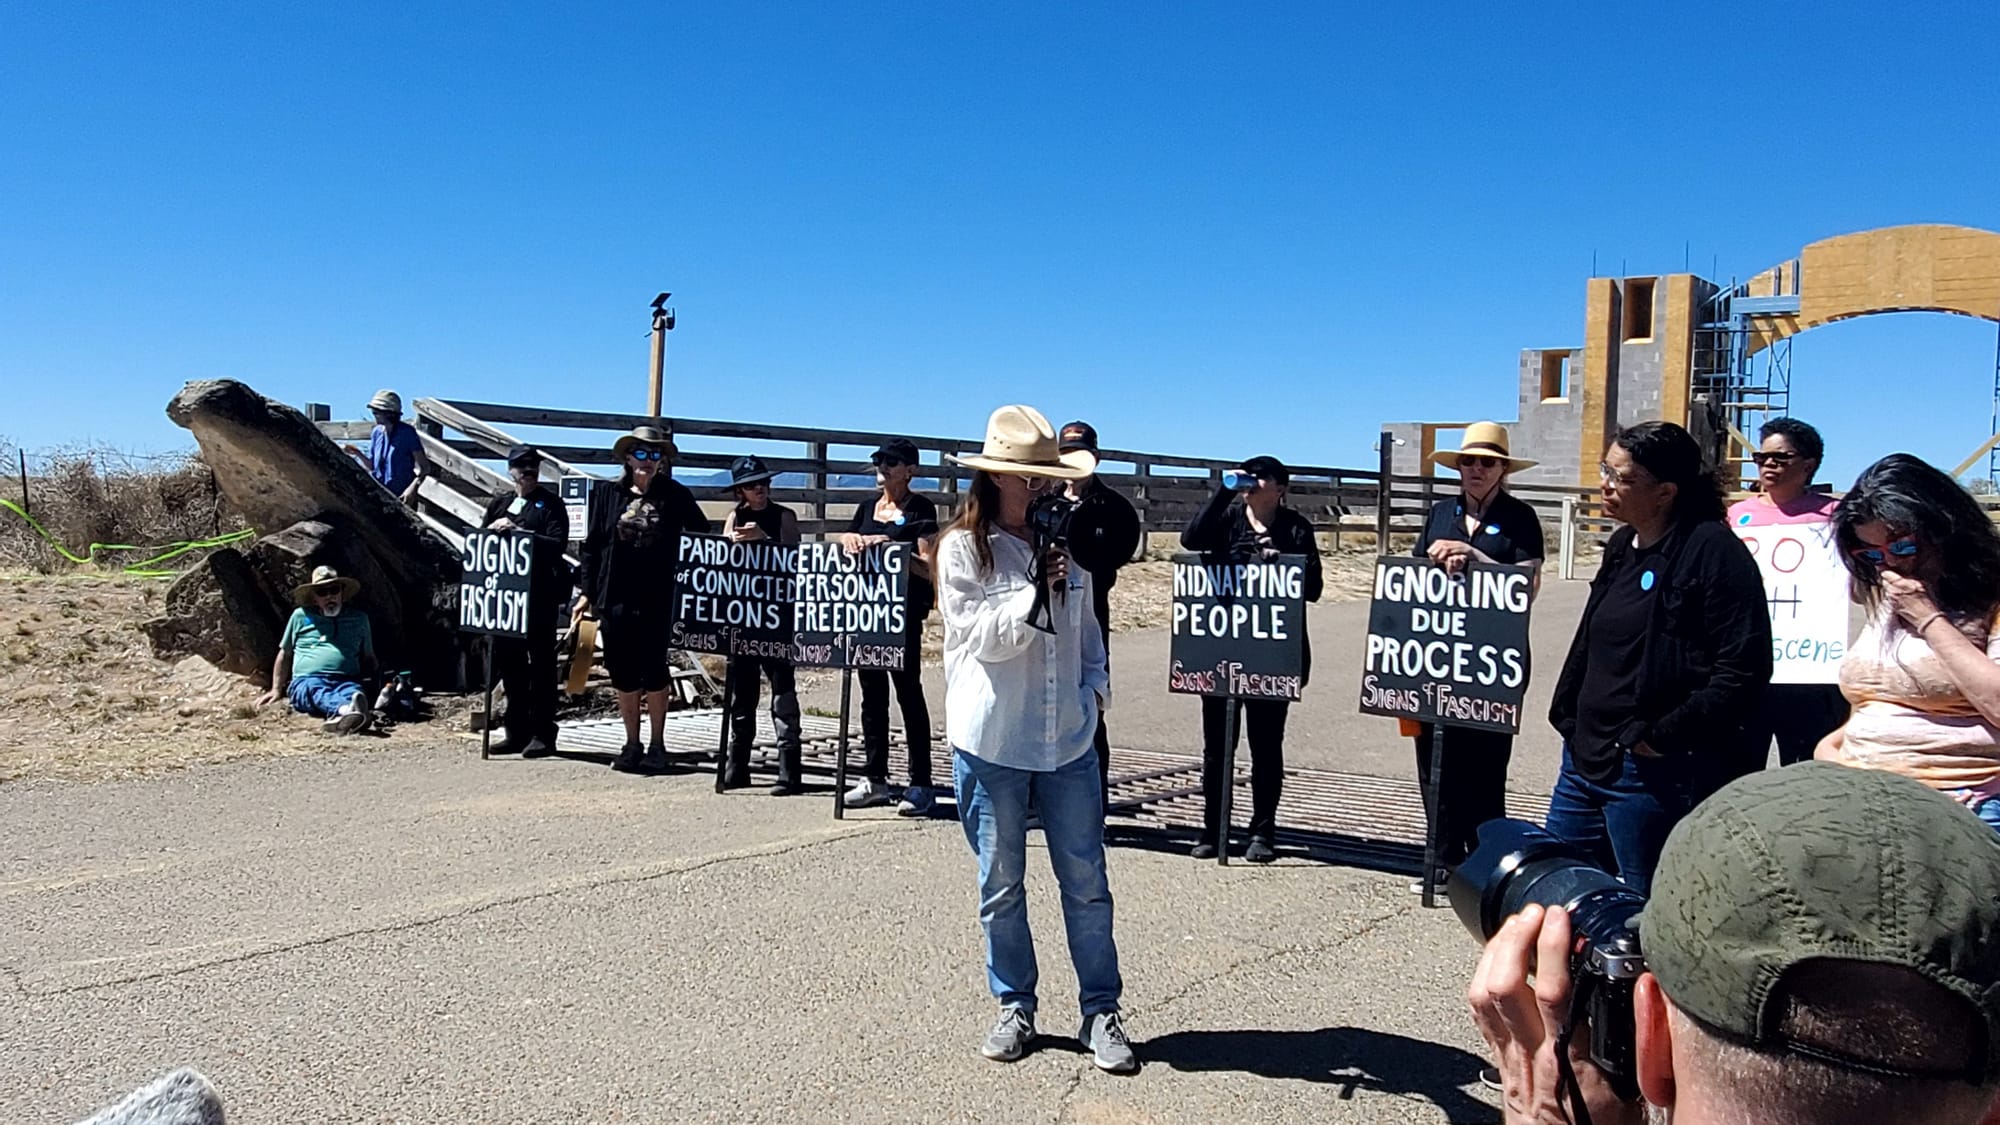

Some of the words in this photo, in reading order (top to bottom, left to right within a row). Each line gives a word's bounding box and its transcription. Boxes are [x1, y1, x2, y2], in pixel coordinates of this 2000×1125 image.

[463, 533, 531, 576] SIGNS
[679, 536, 798, 573] PARDONING
[798, 543, 902, 573] ERASING
[485, 573, 499, 590] of
[677, 569, 690, 584] of
[692, 567, 796, 603] CONVICTED
[796, 573, 905, 602] PERSONAL
[1173, 563, 1303, 599] KIDNAPPING
[1374, 564, 1530, 613] IGNORING
[460, 584, 527, 634] FASCISM
[680, 594, 780, 629] FELONS
[794, 602, 905, 633] FREEDOMS
[1172, 602, 1288, 640] PEOPLE
[1411, 608, 1467, 637] DUE
[1366, 634, 1523, 688] PROCESS
